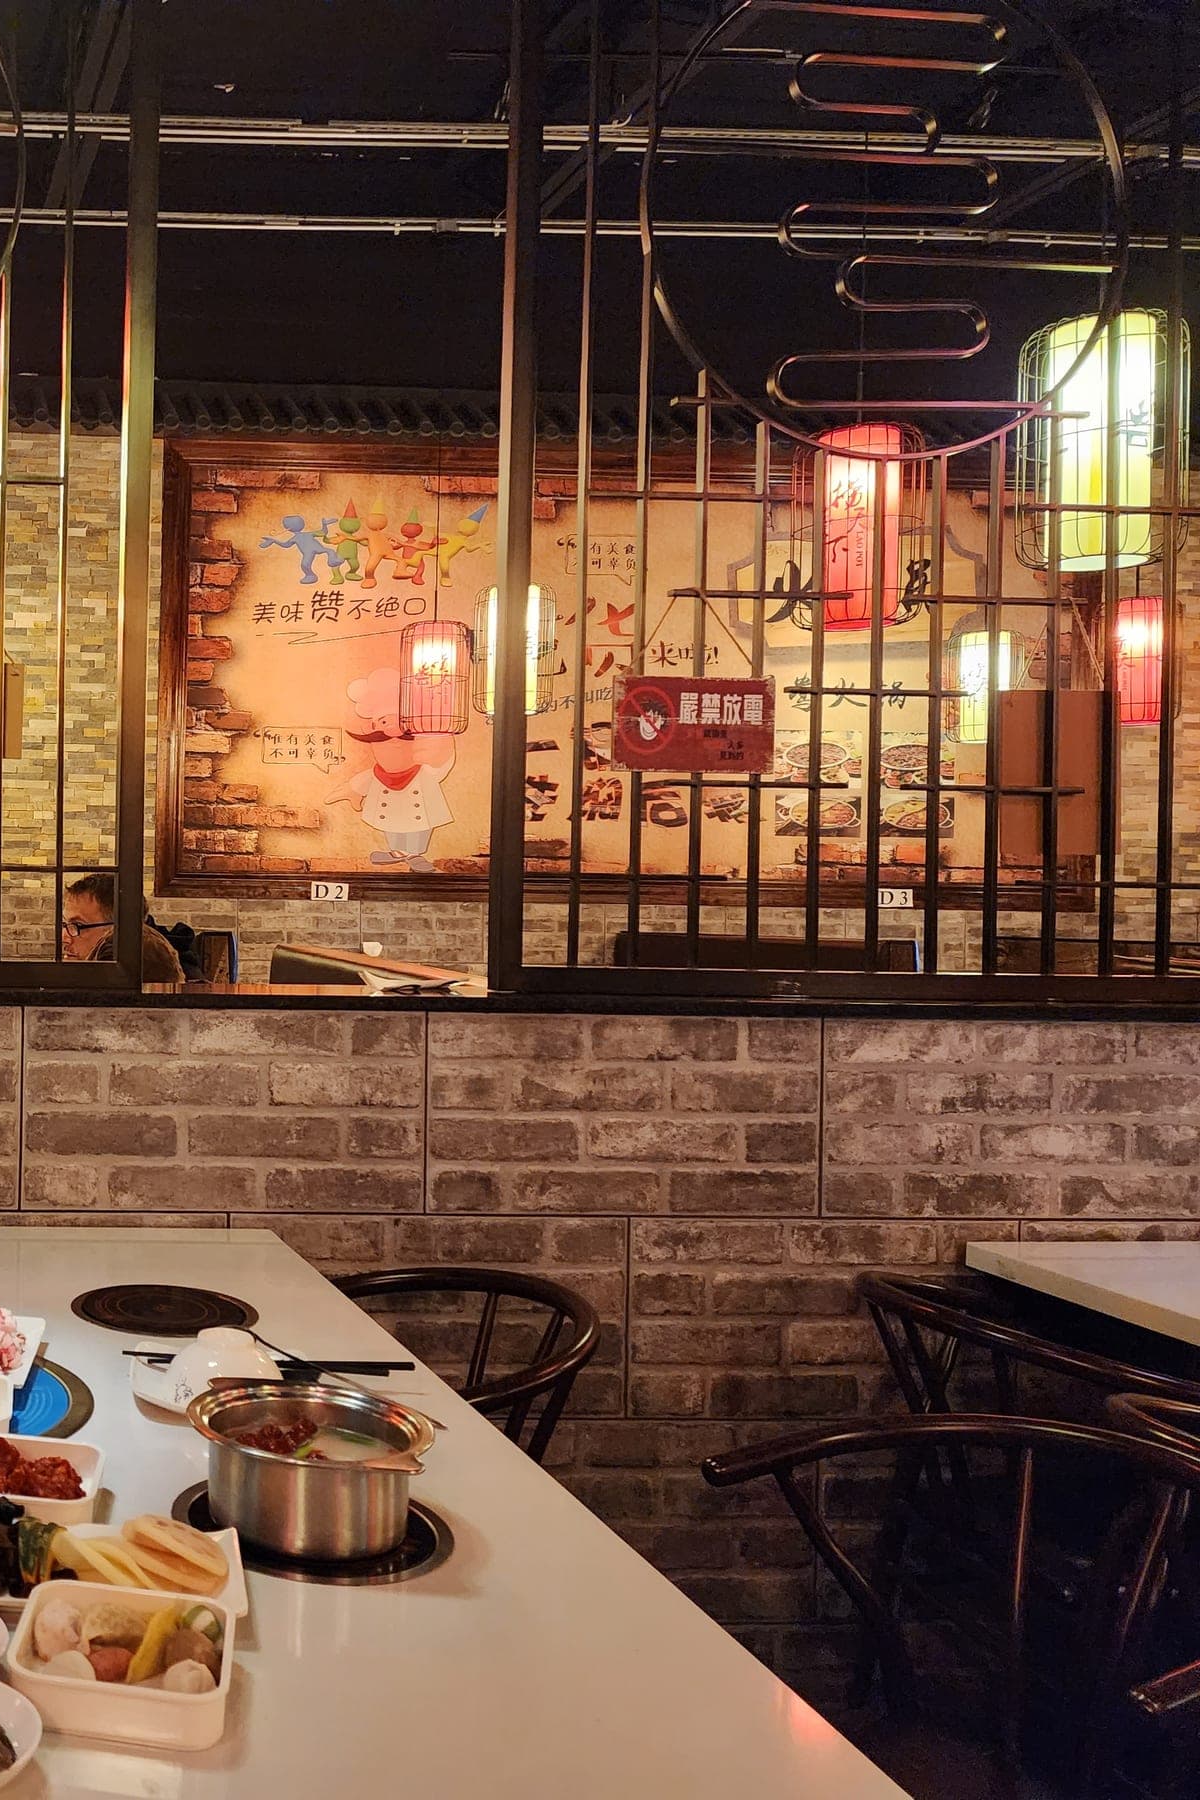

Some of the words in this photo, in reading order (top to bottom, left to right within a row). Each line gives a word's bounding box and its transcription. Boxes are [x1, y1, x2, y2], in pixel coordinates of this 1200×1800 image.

[251, 590, 427, 625] 美味赞不绝口
[678, 692, 764, 726] 嚴禁放電
